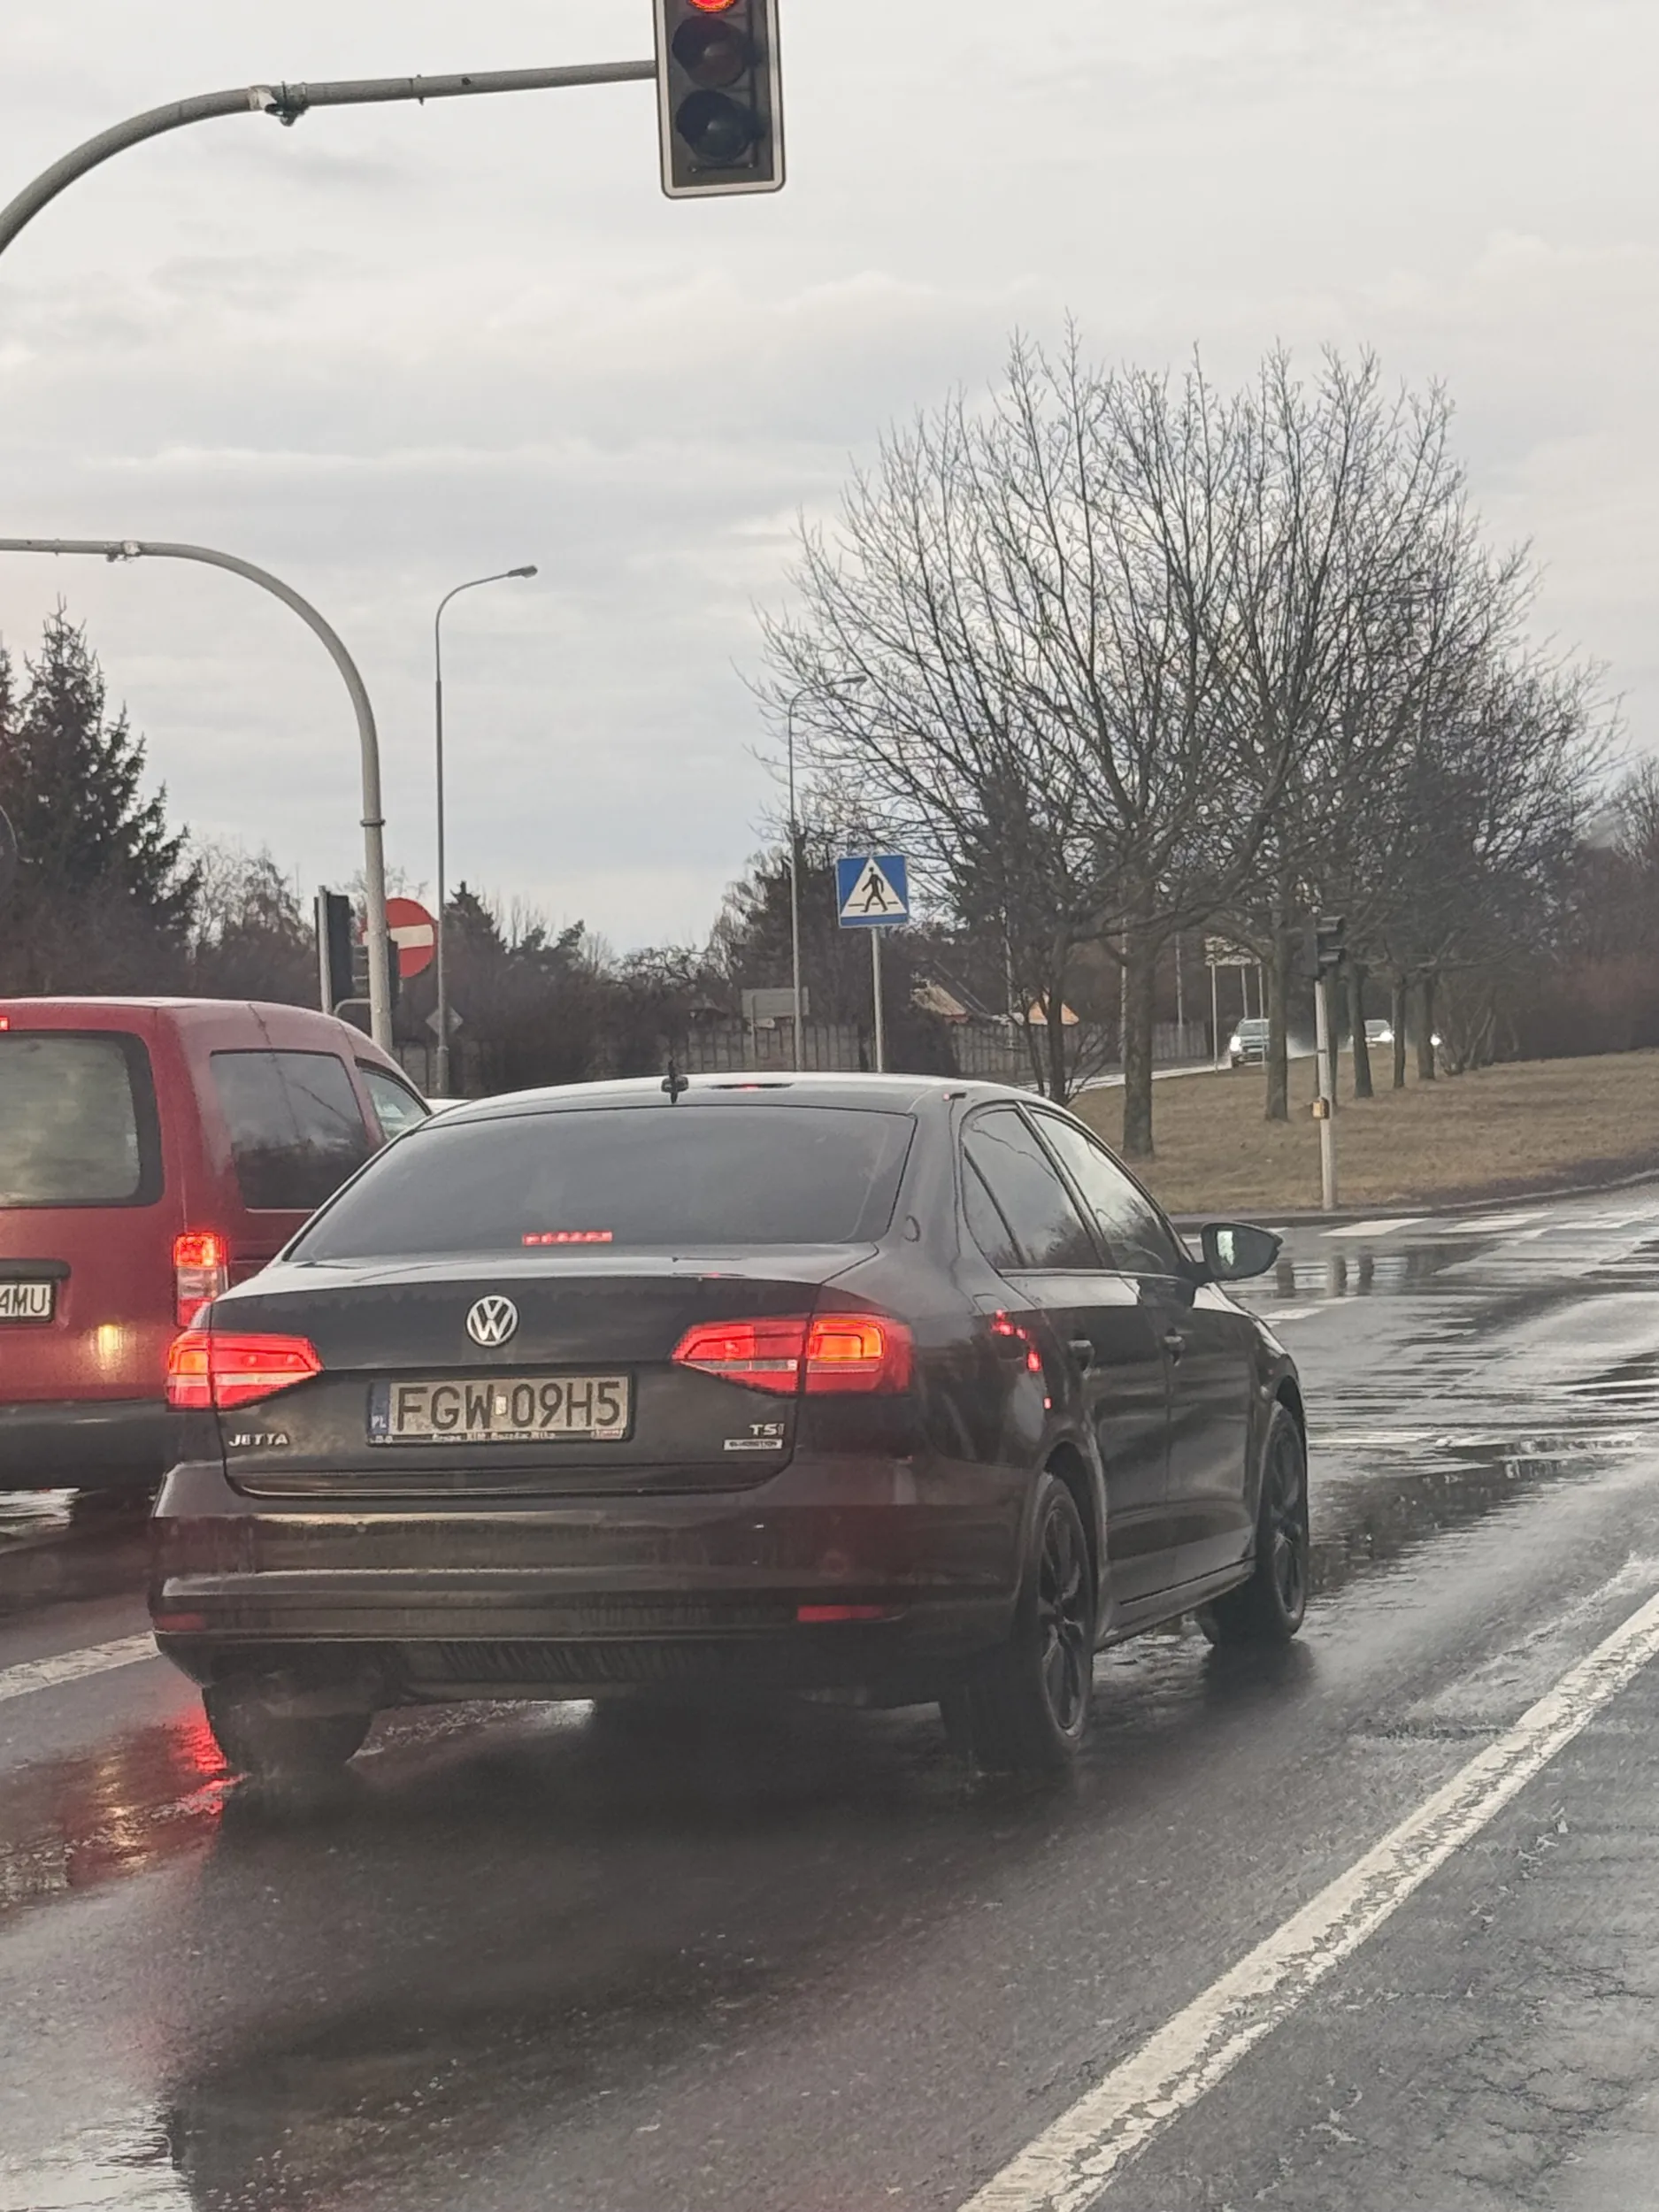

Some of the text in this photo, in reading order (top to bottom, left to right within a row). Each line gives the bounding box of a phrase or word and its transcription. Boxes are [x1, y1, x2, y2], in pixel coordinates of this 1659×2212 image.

[466, 1294, 518, 1347] VW
[371, 1415, 388, 1430] PL
[396, 1380, 620, 1432] FGW 09H5
[228, 1433, 289, 1447] JETTA
